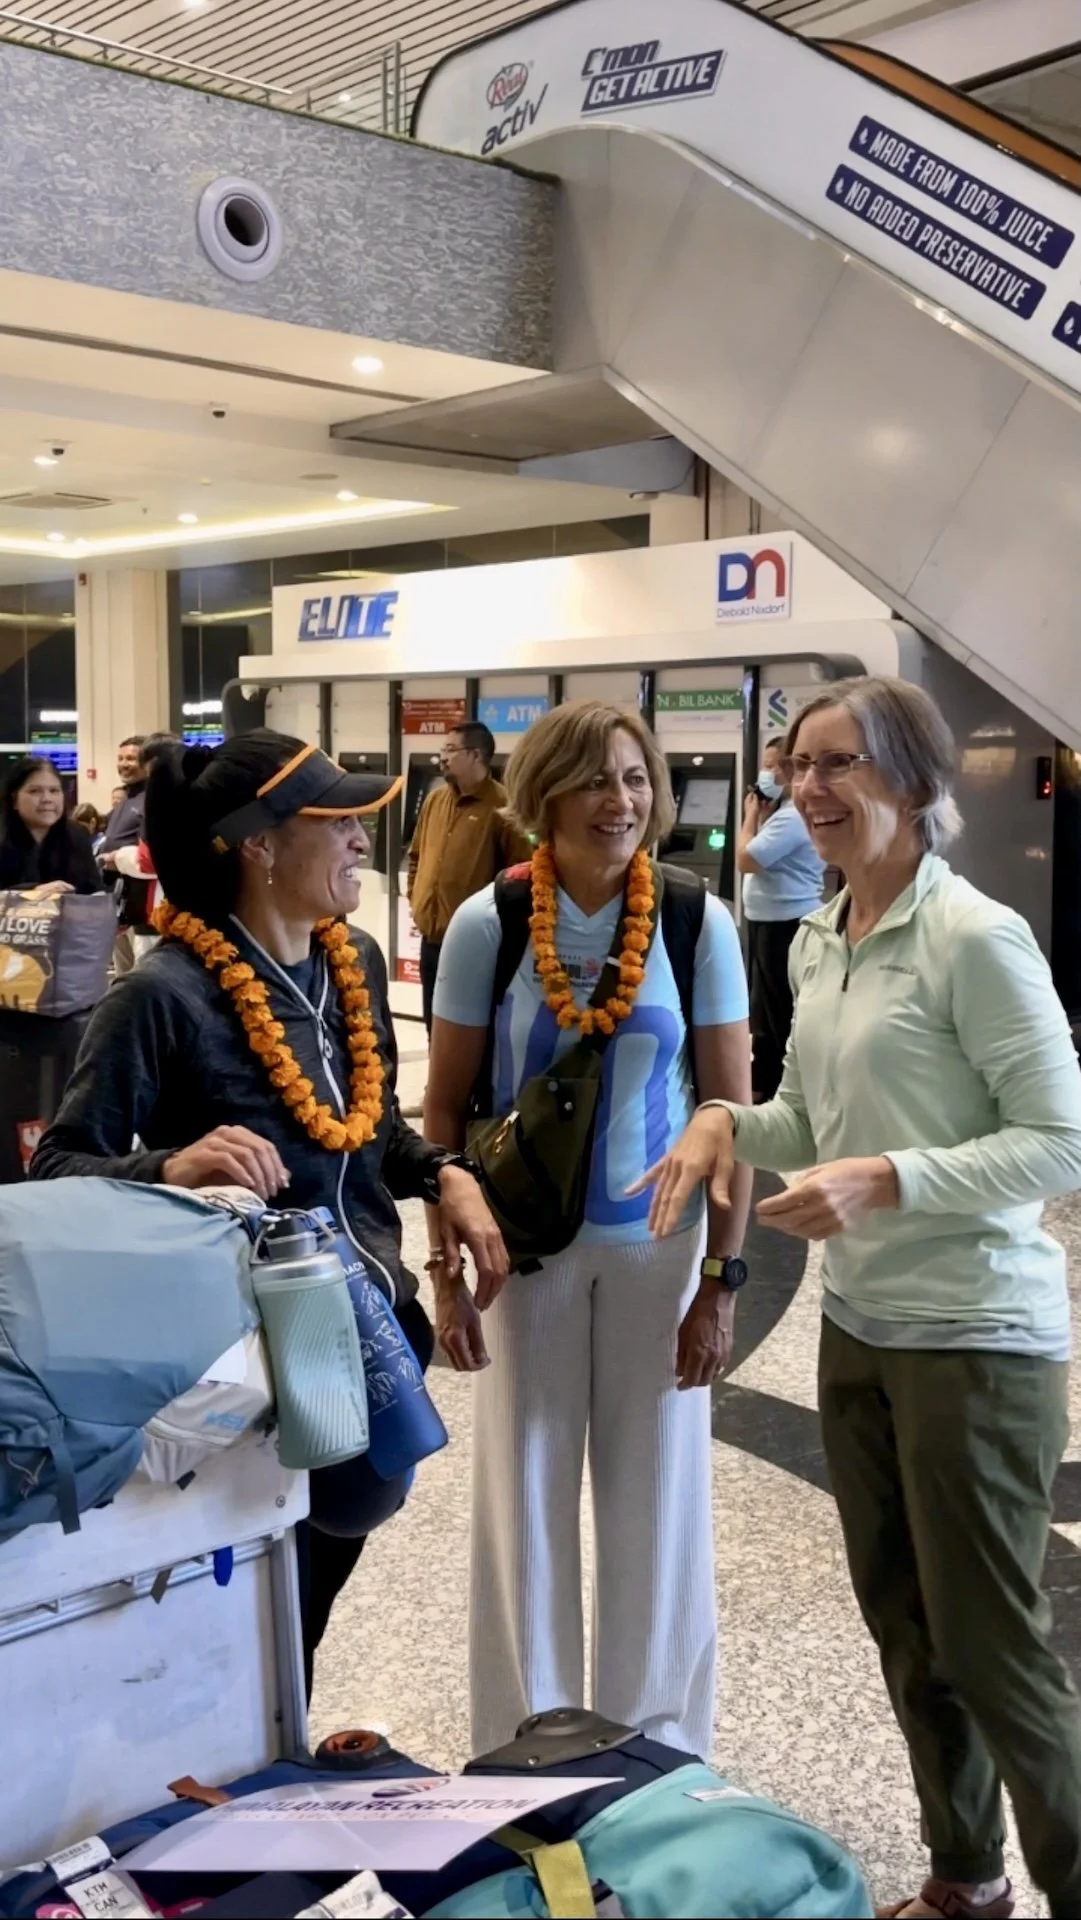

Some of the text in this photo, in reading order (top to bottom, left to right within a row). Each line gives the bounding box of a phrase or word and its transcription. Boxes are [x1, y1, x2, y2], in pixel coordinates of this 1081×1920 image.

[589, 56, 717, 105] GET ACTIVE
[481, 82, 549, 155] activ
[868, 130, 1054, 253] MADE FROM 100% JUICE
[844, 180, 1031, 309] NO ADDED PRESERVATIVE
[298, 591, 399, 642] ELITE
[507, 704, 543, 723] ATM
[697, 693, 735, 707] BANK
[419, 721, 446, 733] ATM
[7, 917, 51, 935] LOVE
[226, 1799, 537, 1811] MALAYAN RECREATION
